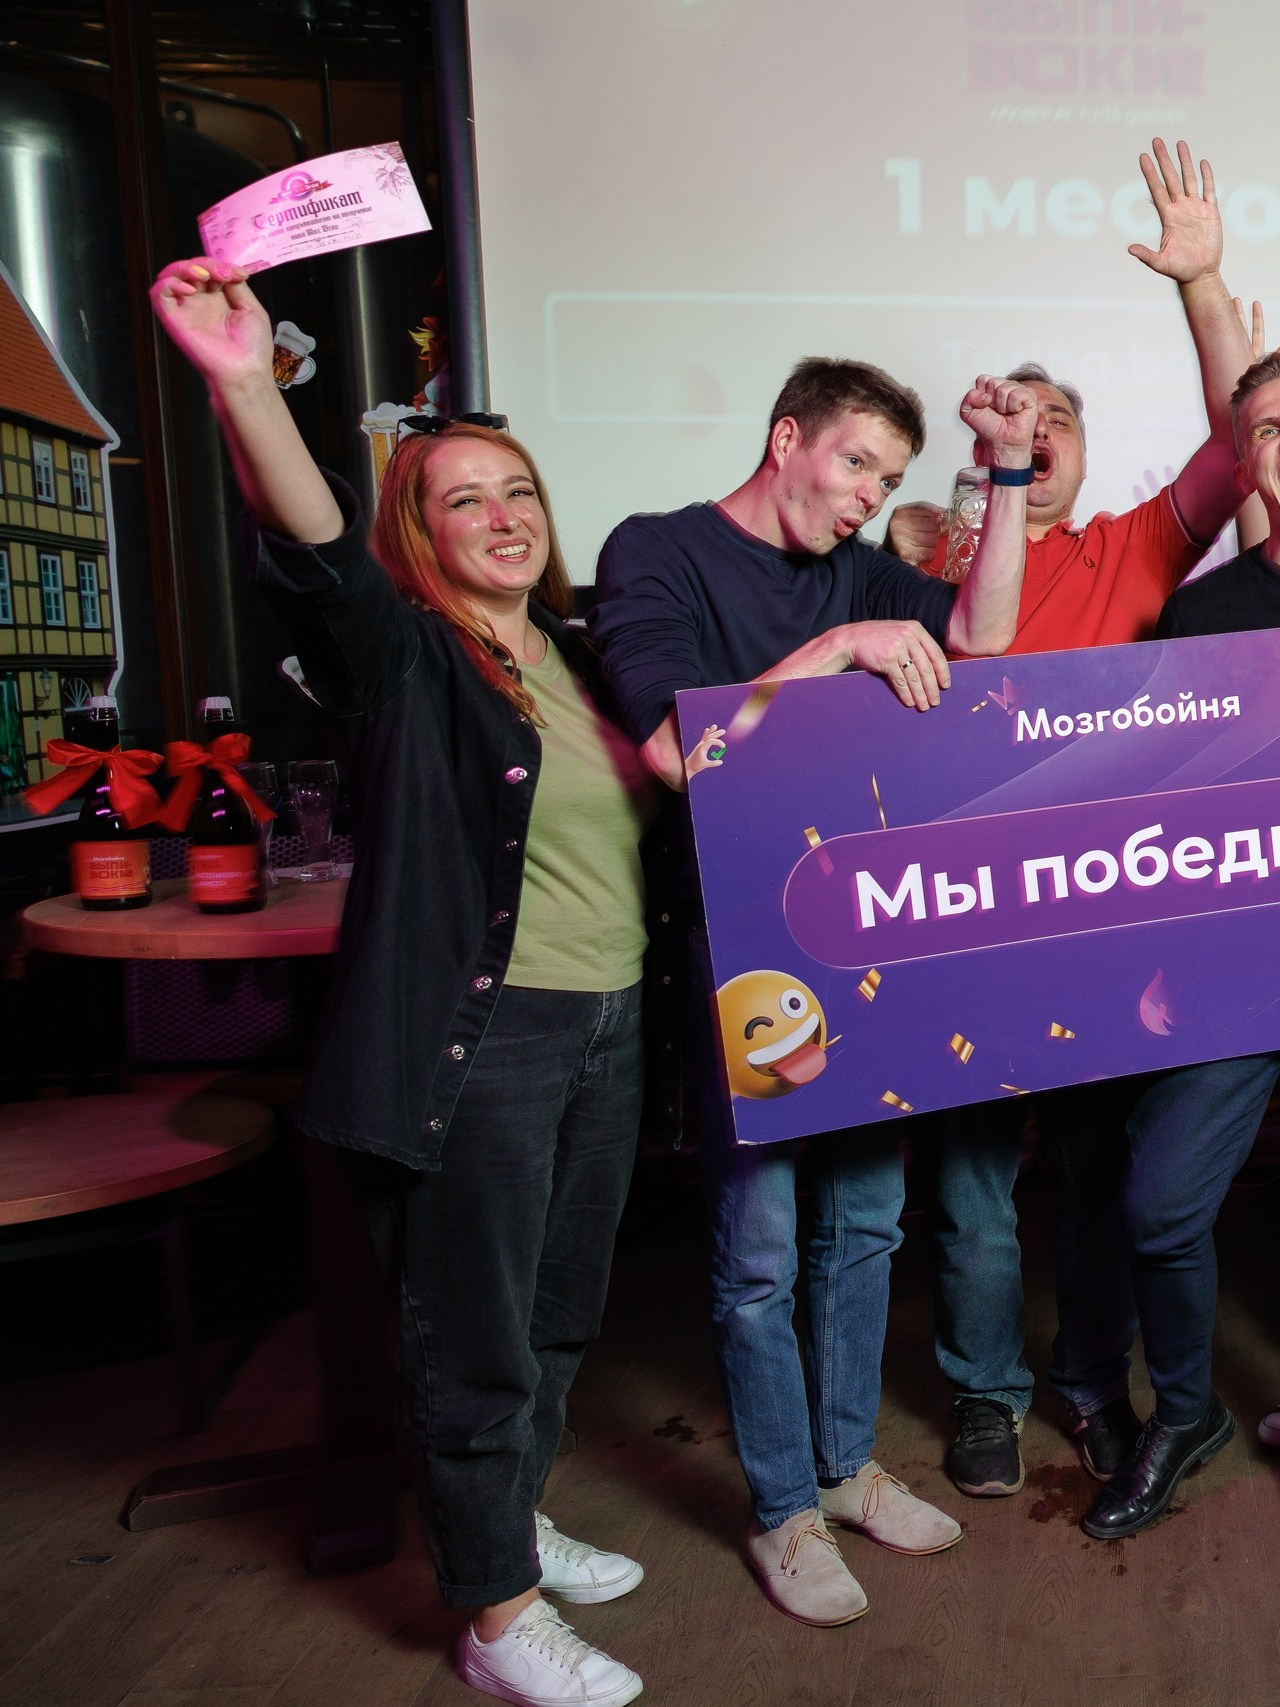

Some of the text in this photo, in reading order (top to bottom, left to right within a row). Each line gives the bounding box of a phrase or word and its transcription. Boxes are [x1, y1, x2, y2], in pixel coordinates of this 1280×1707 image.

[253, 191, 363, 230] Сертификат
[885, 158, 922, 235] 1
[1015, 692, 1242, 743] Мозгобойня
[855, 862, 995, 929] Мы
